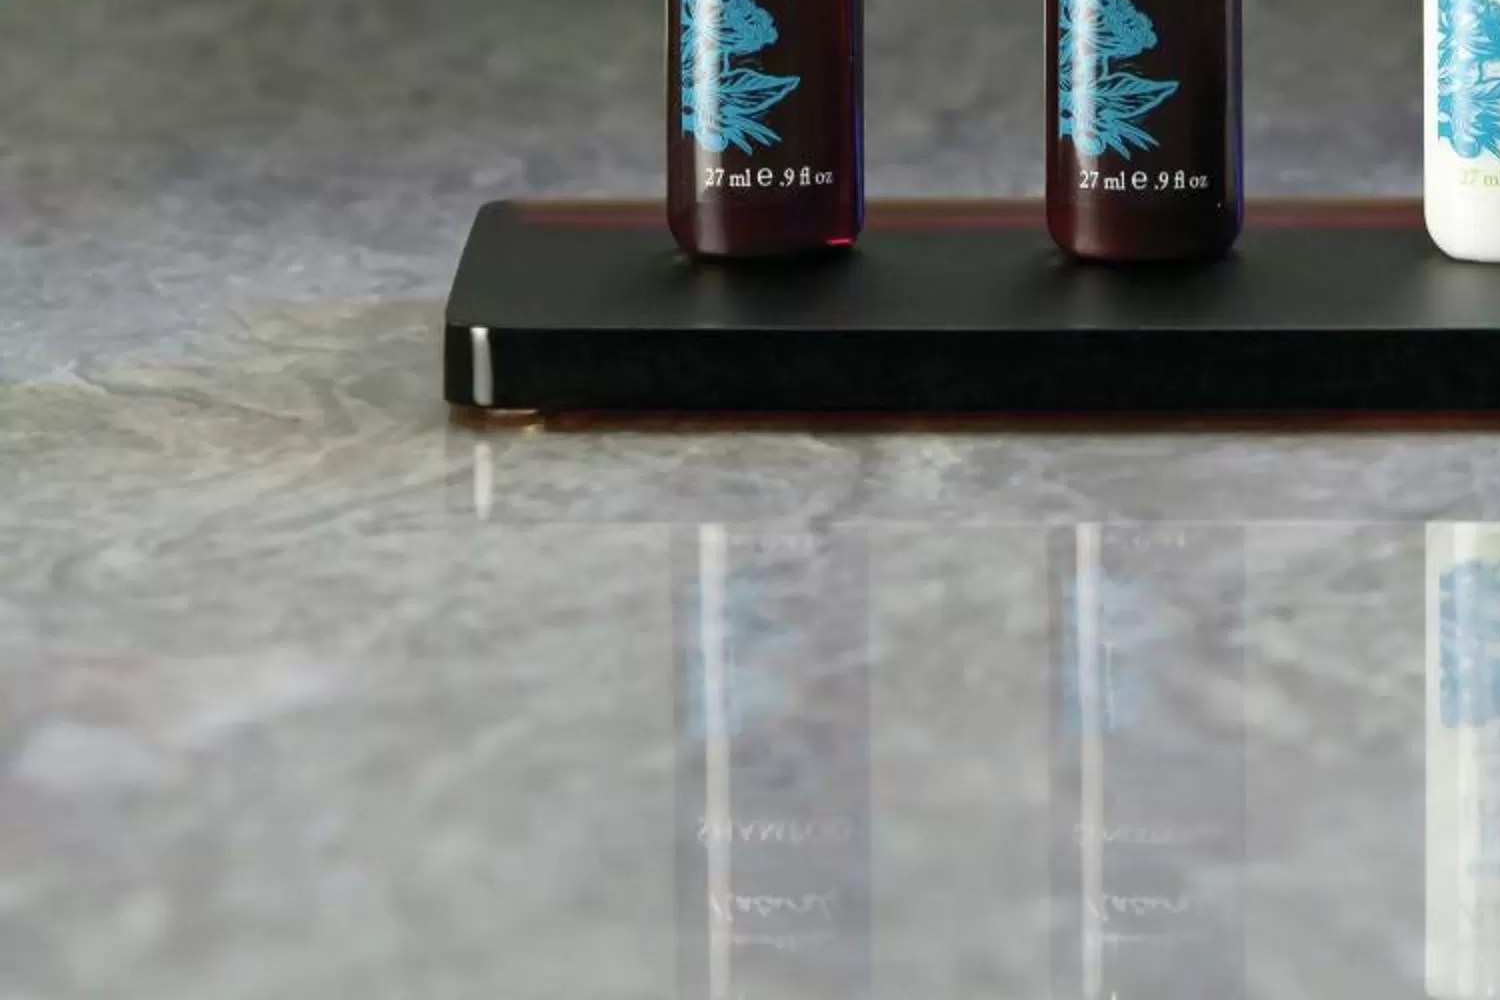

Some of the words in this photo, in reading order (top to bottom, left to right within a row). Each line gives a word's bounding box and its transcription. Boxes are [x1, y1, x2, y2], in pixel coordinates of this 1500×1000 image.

[705, 168, 724, 187] 27
[730, 169, 751, 187] ml
[800, 166, 811, 185] fl
[815, 171, 833, 185] oz
[1079, 170, 1099, 189] 27
[1104, 171, 1125, 190] ml
[1174, 169, 1185, 189] fl
[1189, 174, 1208, 188] oz
